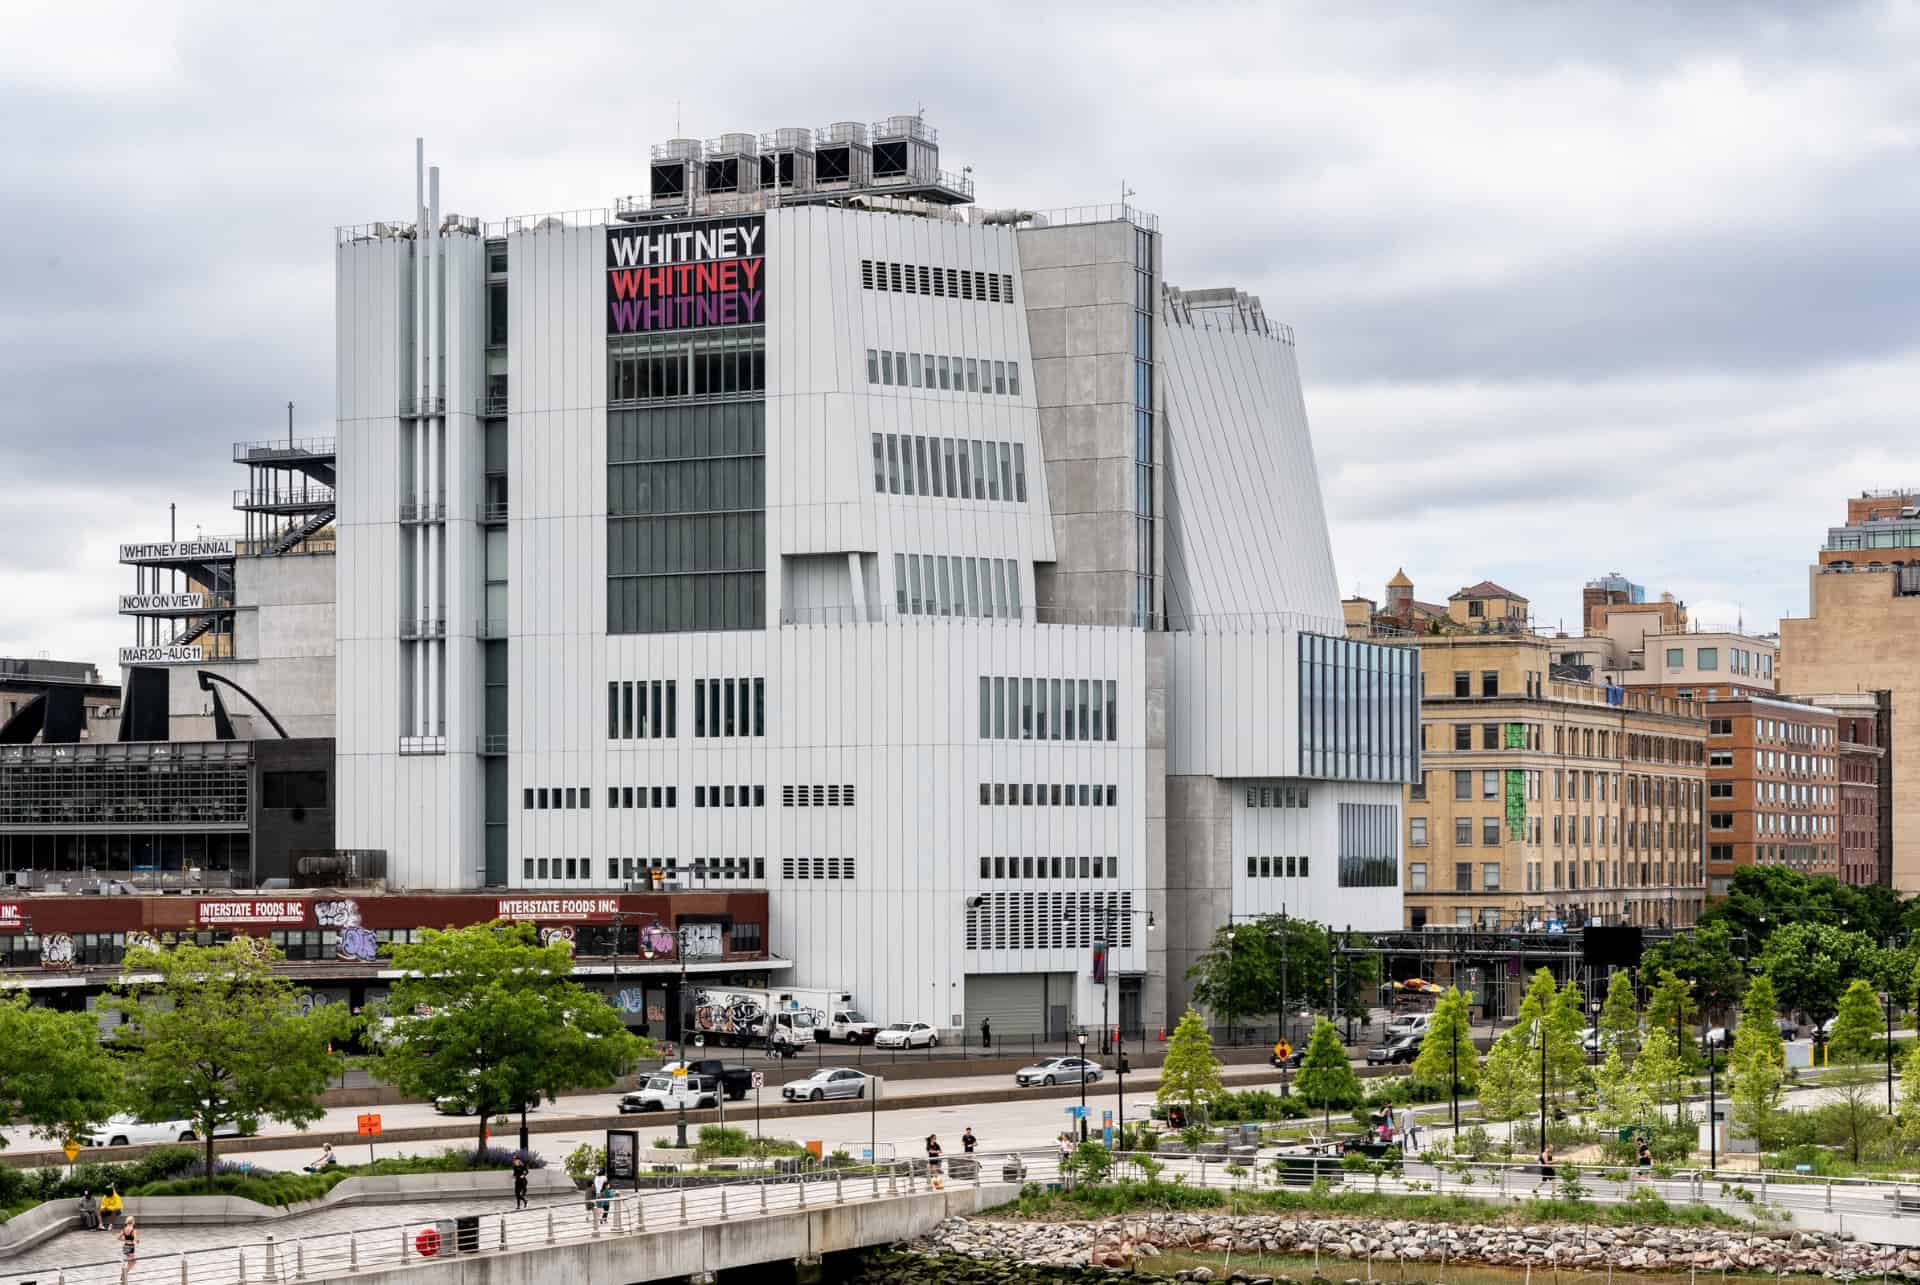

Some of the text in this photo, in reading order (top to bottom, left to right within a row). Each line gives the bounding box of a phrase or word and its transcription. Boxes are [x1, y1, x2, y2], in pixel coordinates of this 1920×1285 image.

[611, 225, 761, 268] WHITNEY
[611, 258, 763, 300] WHITNEY
[610, 289, 763, 332] WHITNEY
[124, 541, 233, 558] WHITNEY BIENNIAL
[123, 594, 201, 609] NOW ON VIEW
[199, 902, 251, 917] INTERSTATE
[255, 902, 285, 917] FOODS
[287, 902, 304, 917] INC.
[499, 899, 619, 914] INTERSTATE FOODS INC.
